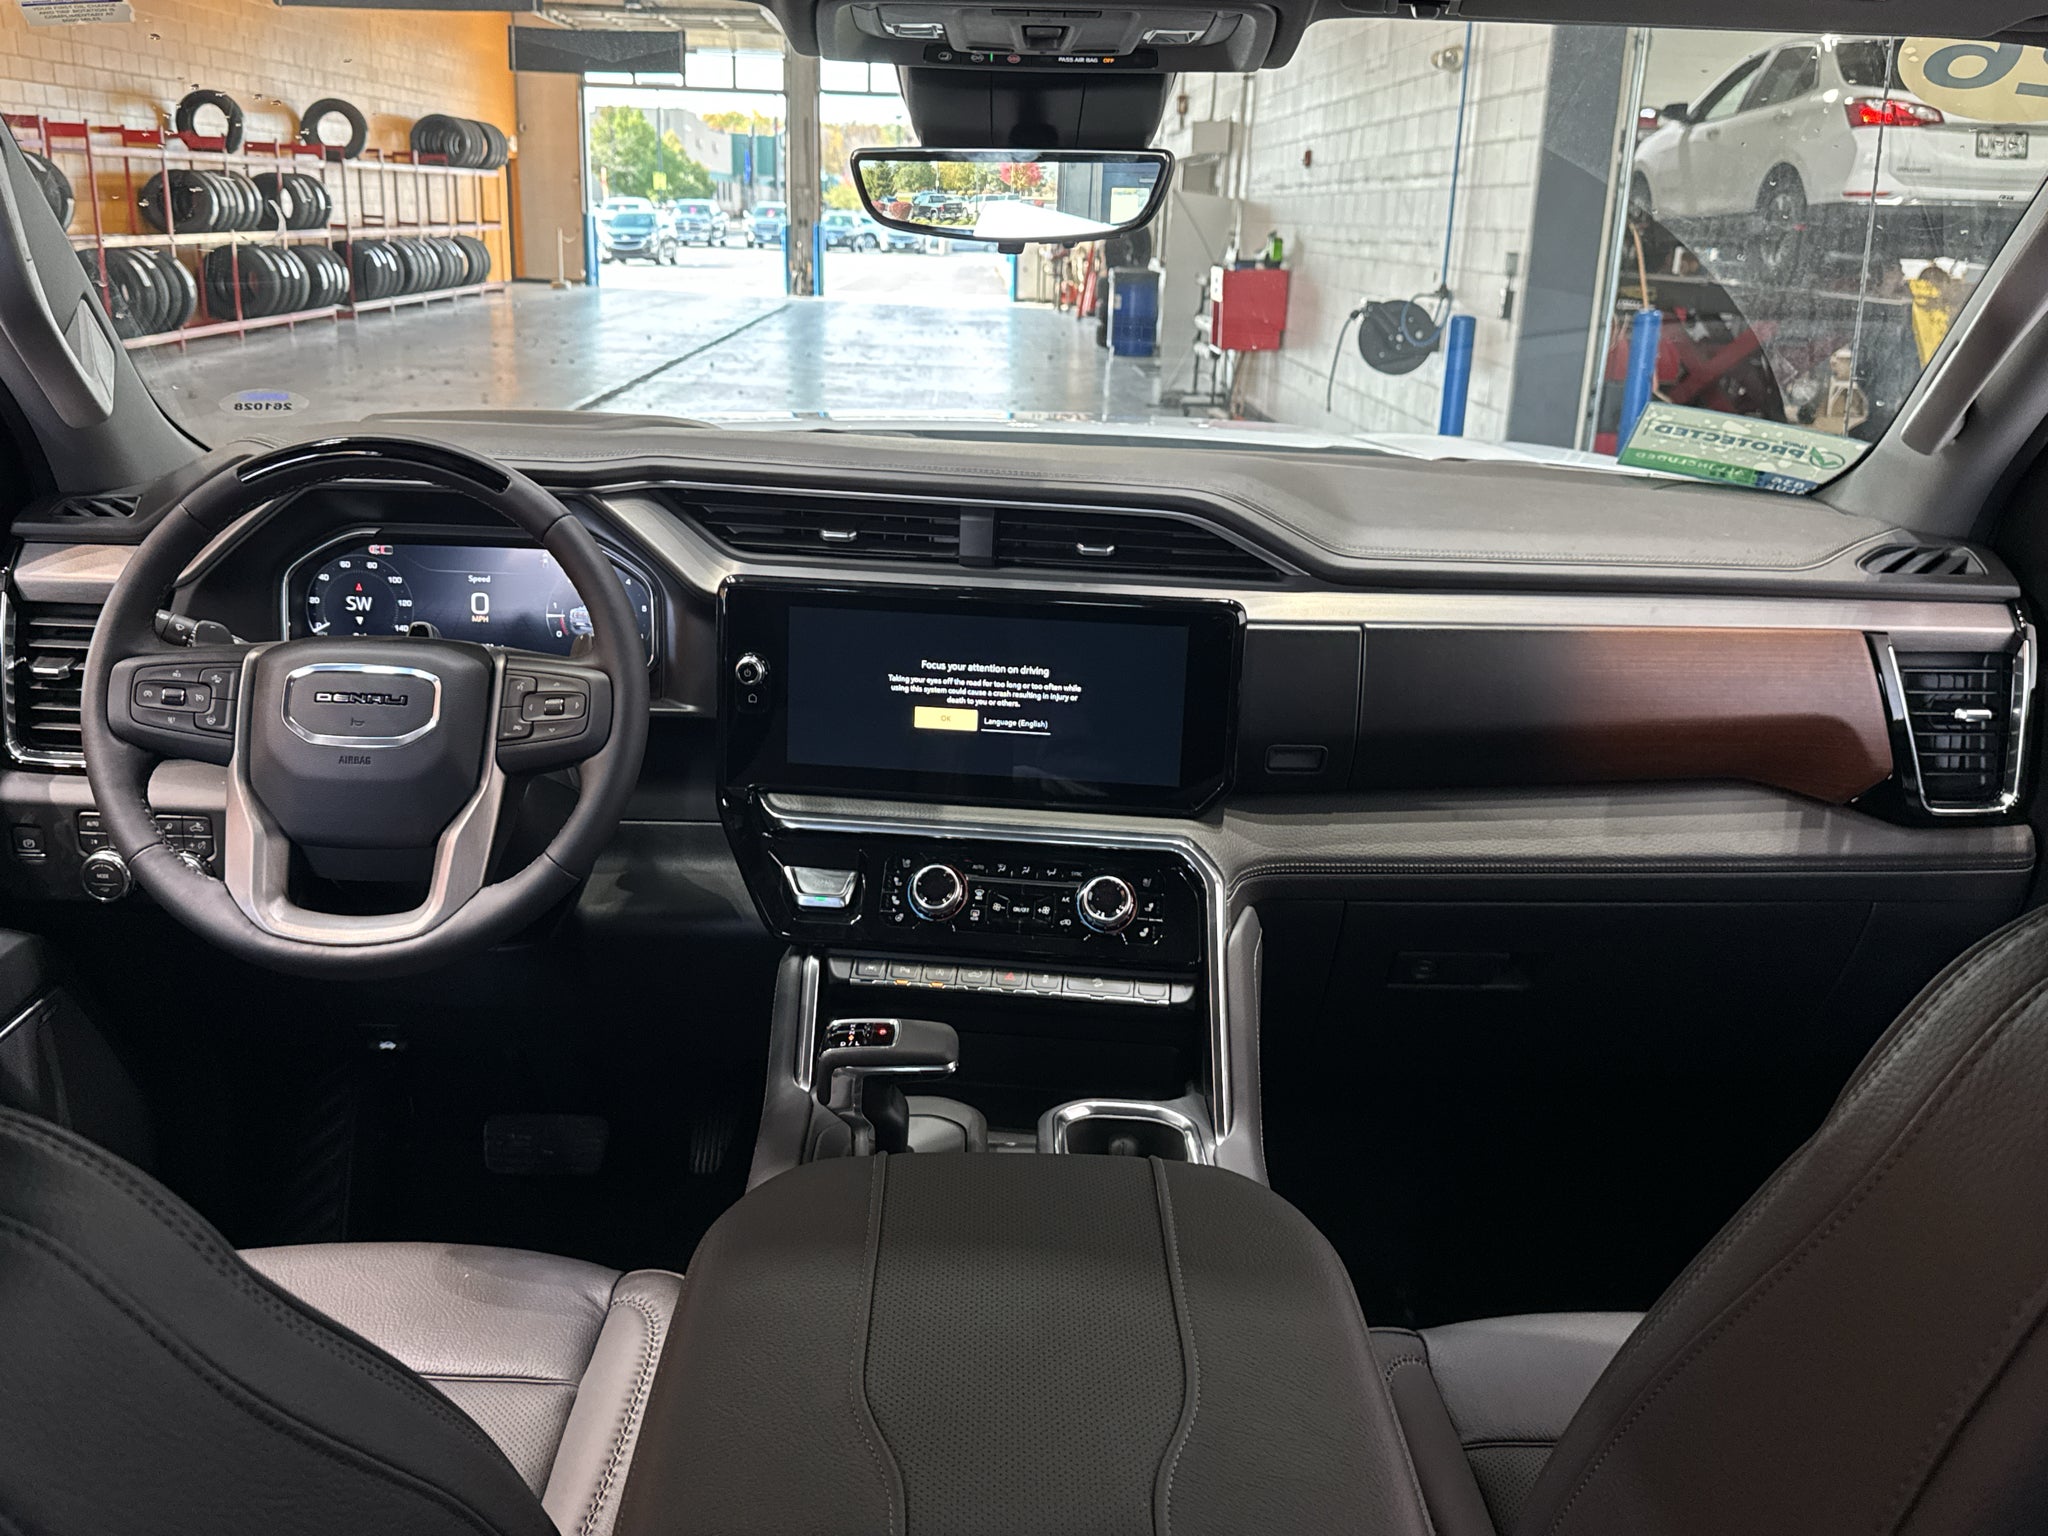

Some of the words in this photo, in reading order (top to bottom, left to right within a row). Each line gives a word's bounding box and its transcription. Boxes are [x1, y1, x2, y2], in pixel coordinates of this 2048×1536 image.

[318, 574, 330, 582] 40
[388, 576, 402, 584] 100
[468, 575, 491, 584] Speed
[625, 578, 632, 586] 4
[309, 596, 320, 604] 20
[345, 596, 373, 612] SW
[470, 592, 490, 615] 0
[471, 616, 490, 624] MPH
[394, 624, 410, 632] 140
[556, 630, 563, 638] 0
[921, 660, 946, 670] Focus
[947, 663, 966, 673] your
[968, 664, 1006, 674] attention
[1008, 666, 1019, 674] on
[1020, 665, 1050, 678] driving
[888, 674, 910, 684] Taking
[954, 678, 965, 686] the
[966, 679, 981, 687] road
[982, 679, 993, 687] for
[1006, 680, 1021, 690] long
[1044, 683, 1062, 691] often
[1063, 684, 1082, 692] while
[890, 684, 909, 694] using
[910, 684, 923, 693] this
[923, 686, 947, 695] system
[948, 687, 966, 695] could
[1012, 691, 1041, 701] resulting
[1050, 693, 1069, 702] injury
[314, 692, 408, 706] DENALI
[946, 696, 966, 704] death
[975, 699, 987, 707] you
[997, 699, 1021, 707] others.
[984, 717, 1017, 728] Language
[1018, 718, 1048, 729] (English)
[338, 756, 372, 765] AIRBAG
